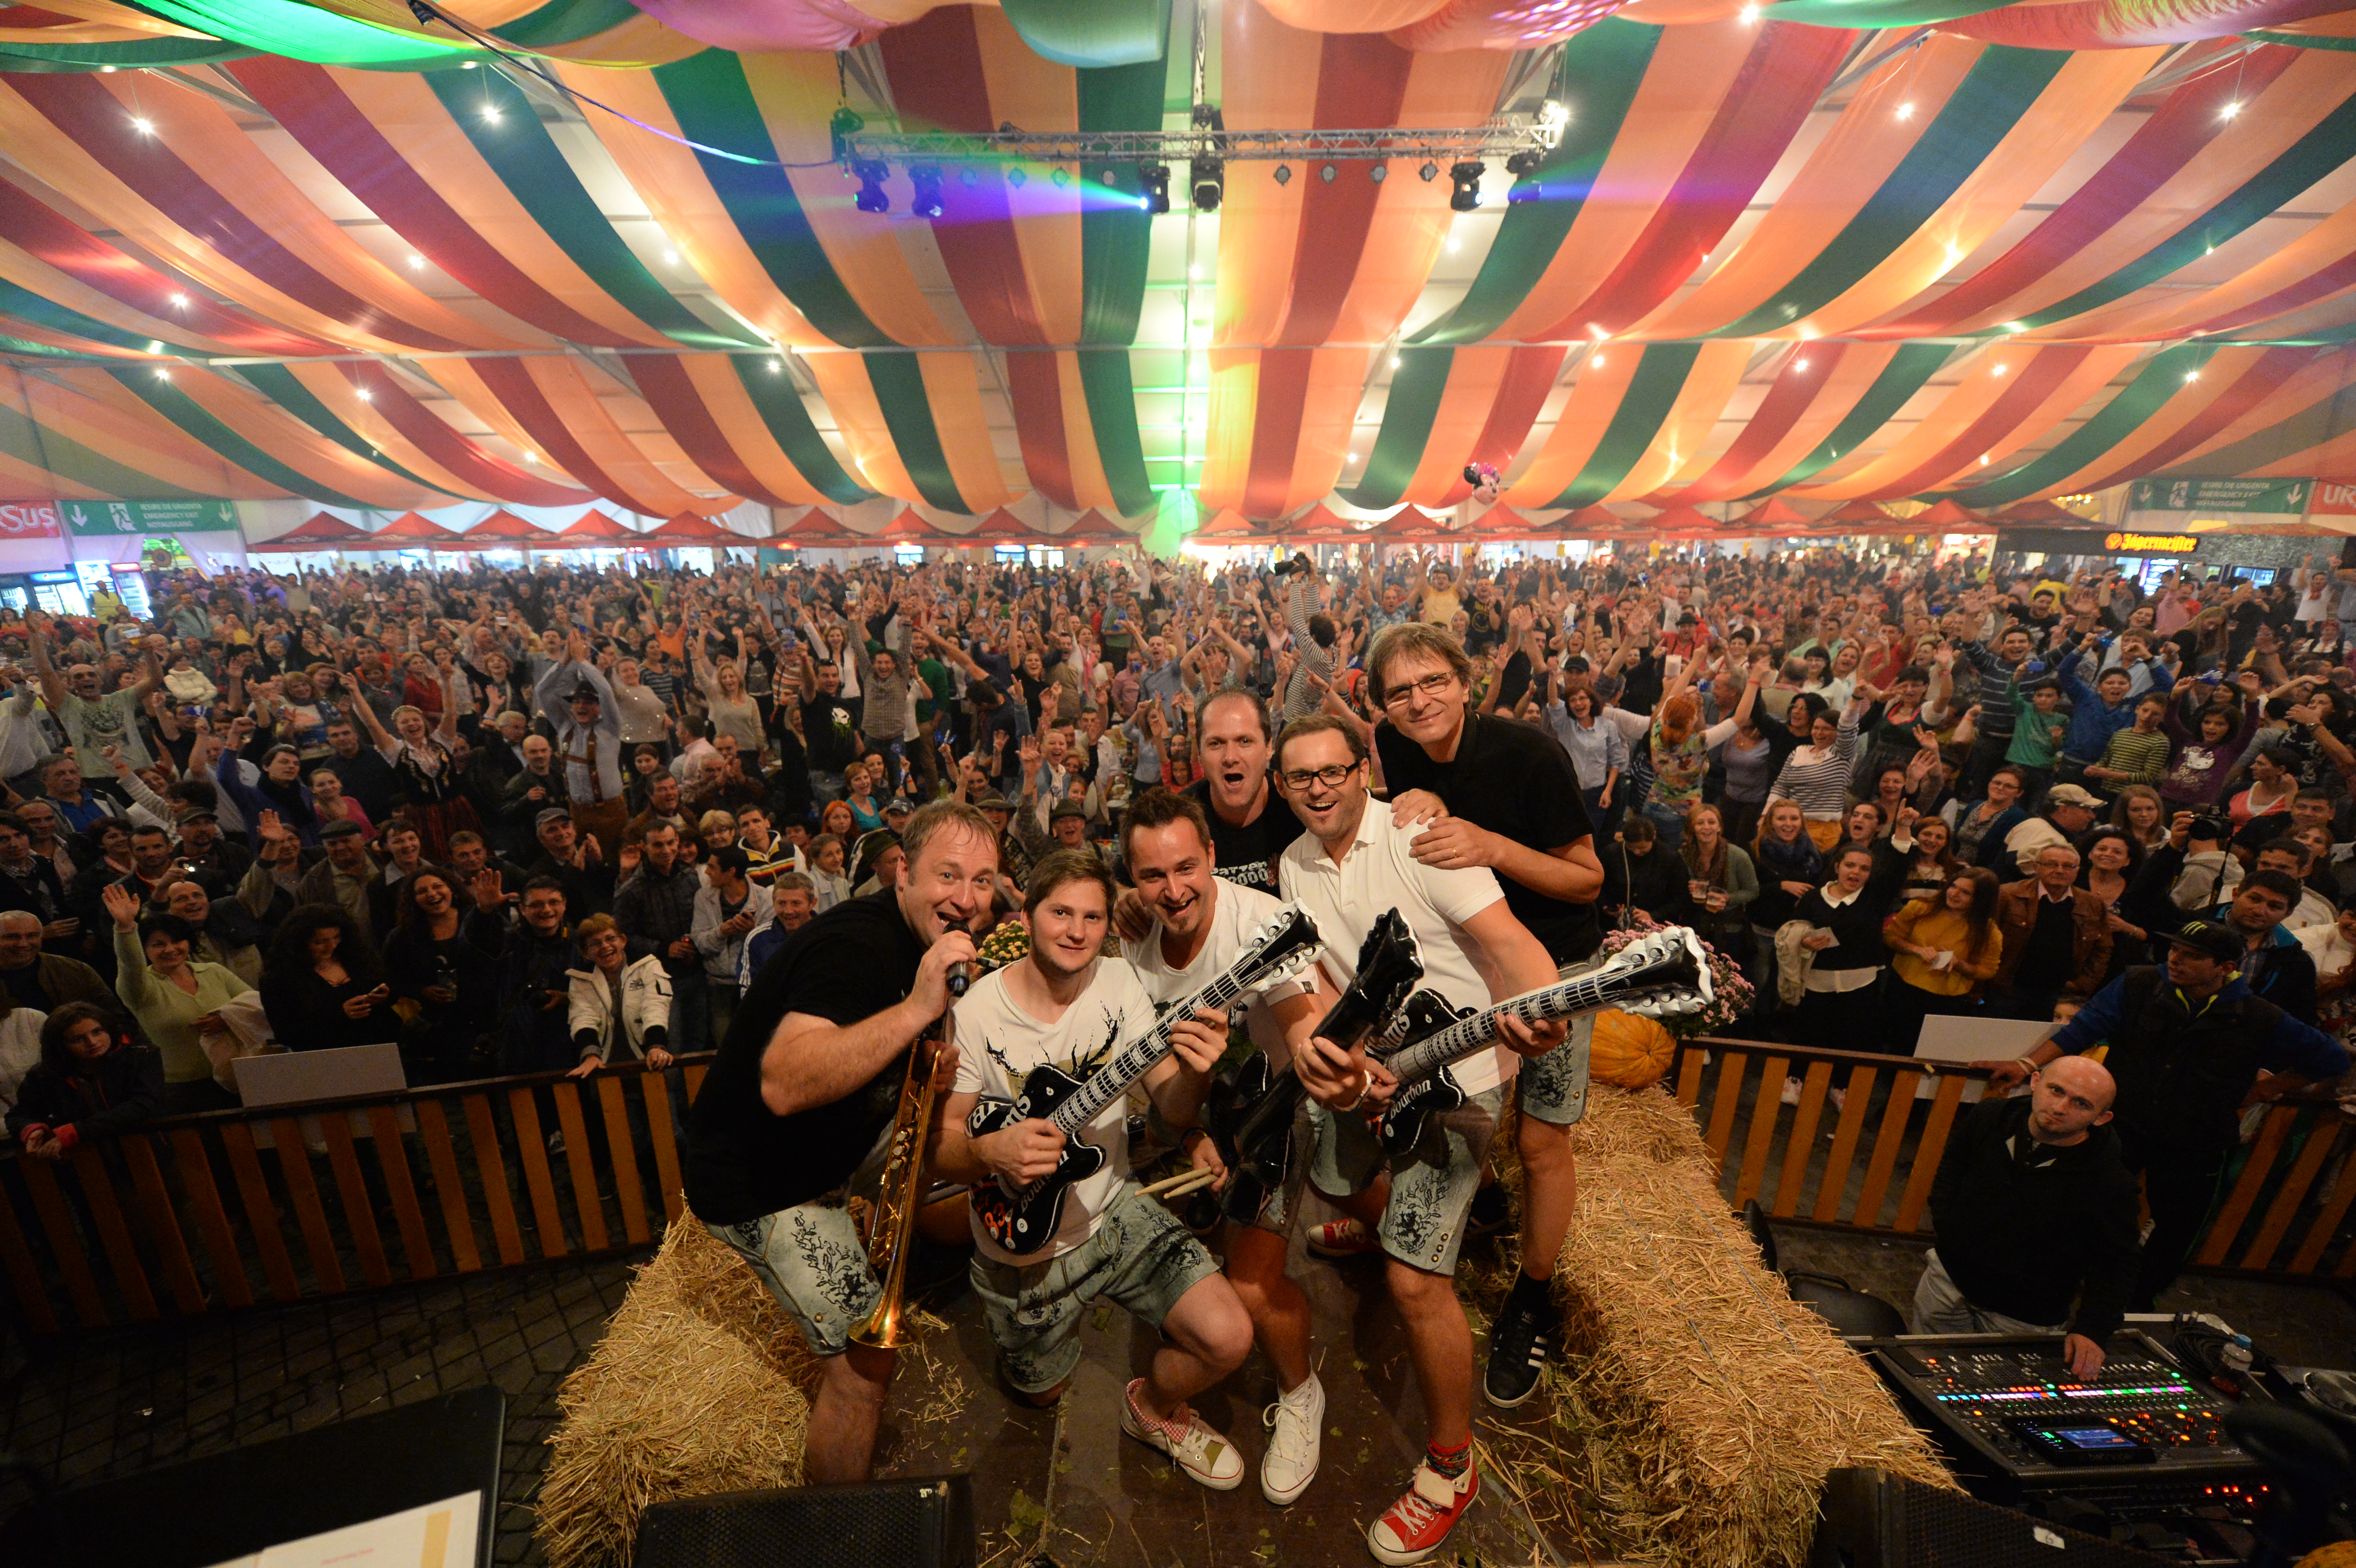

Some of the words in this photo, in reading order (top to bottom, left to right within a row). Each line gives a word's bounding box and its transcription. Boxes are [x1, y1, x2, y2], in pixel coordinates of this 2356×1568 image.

[2323, 485, 2356, 506] UR
[1390, 1079, 1432, 1121] Bourbon
[1021, 1150, 1069, 1213] Bourn
